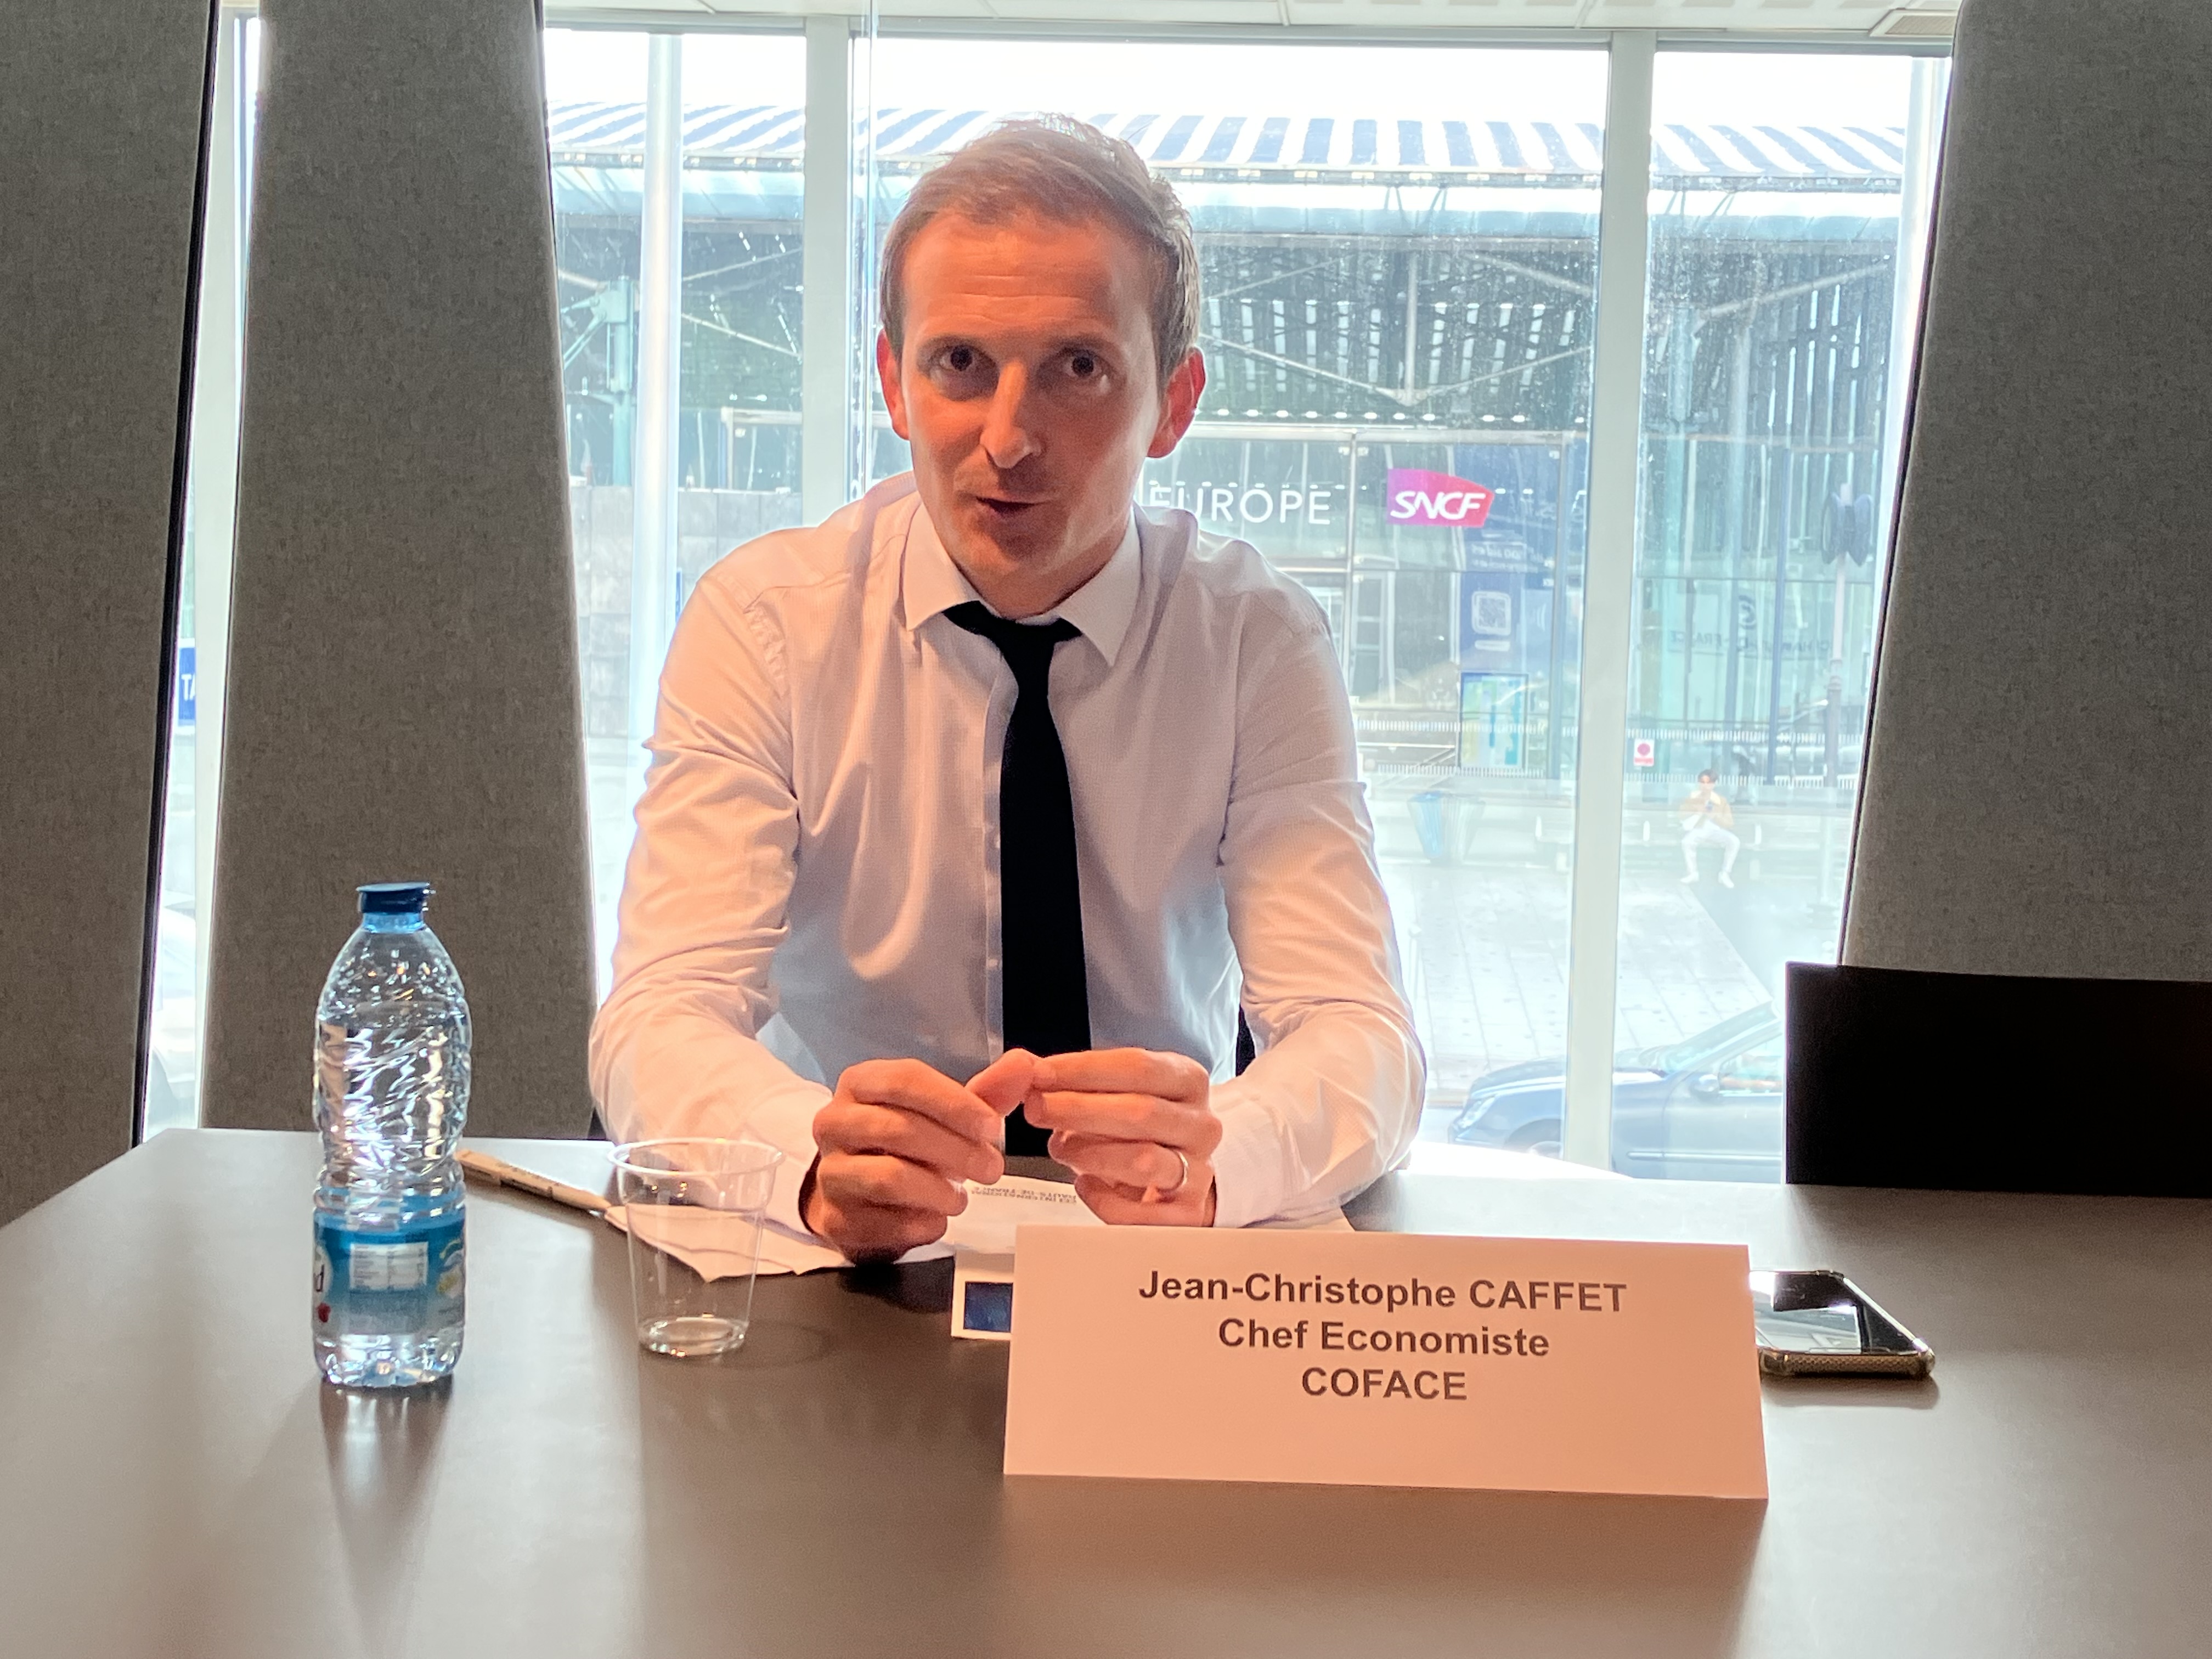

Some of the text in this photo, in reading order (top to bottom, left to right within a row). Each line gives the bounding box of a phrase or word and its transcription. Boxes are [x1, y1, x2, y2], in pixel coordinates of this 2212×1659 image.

[1149, 487, 1331, 525] EUROPE
[1390, 490, 1487, 520] SNCF
[1138, 1270, 1627, 1313] Jean-Christophe CAFFET
[1218, 1317, 1549, 1356] Chef Economiste
[1301, 1367, 1468, 1401] COFACE
